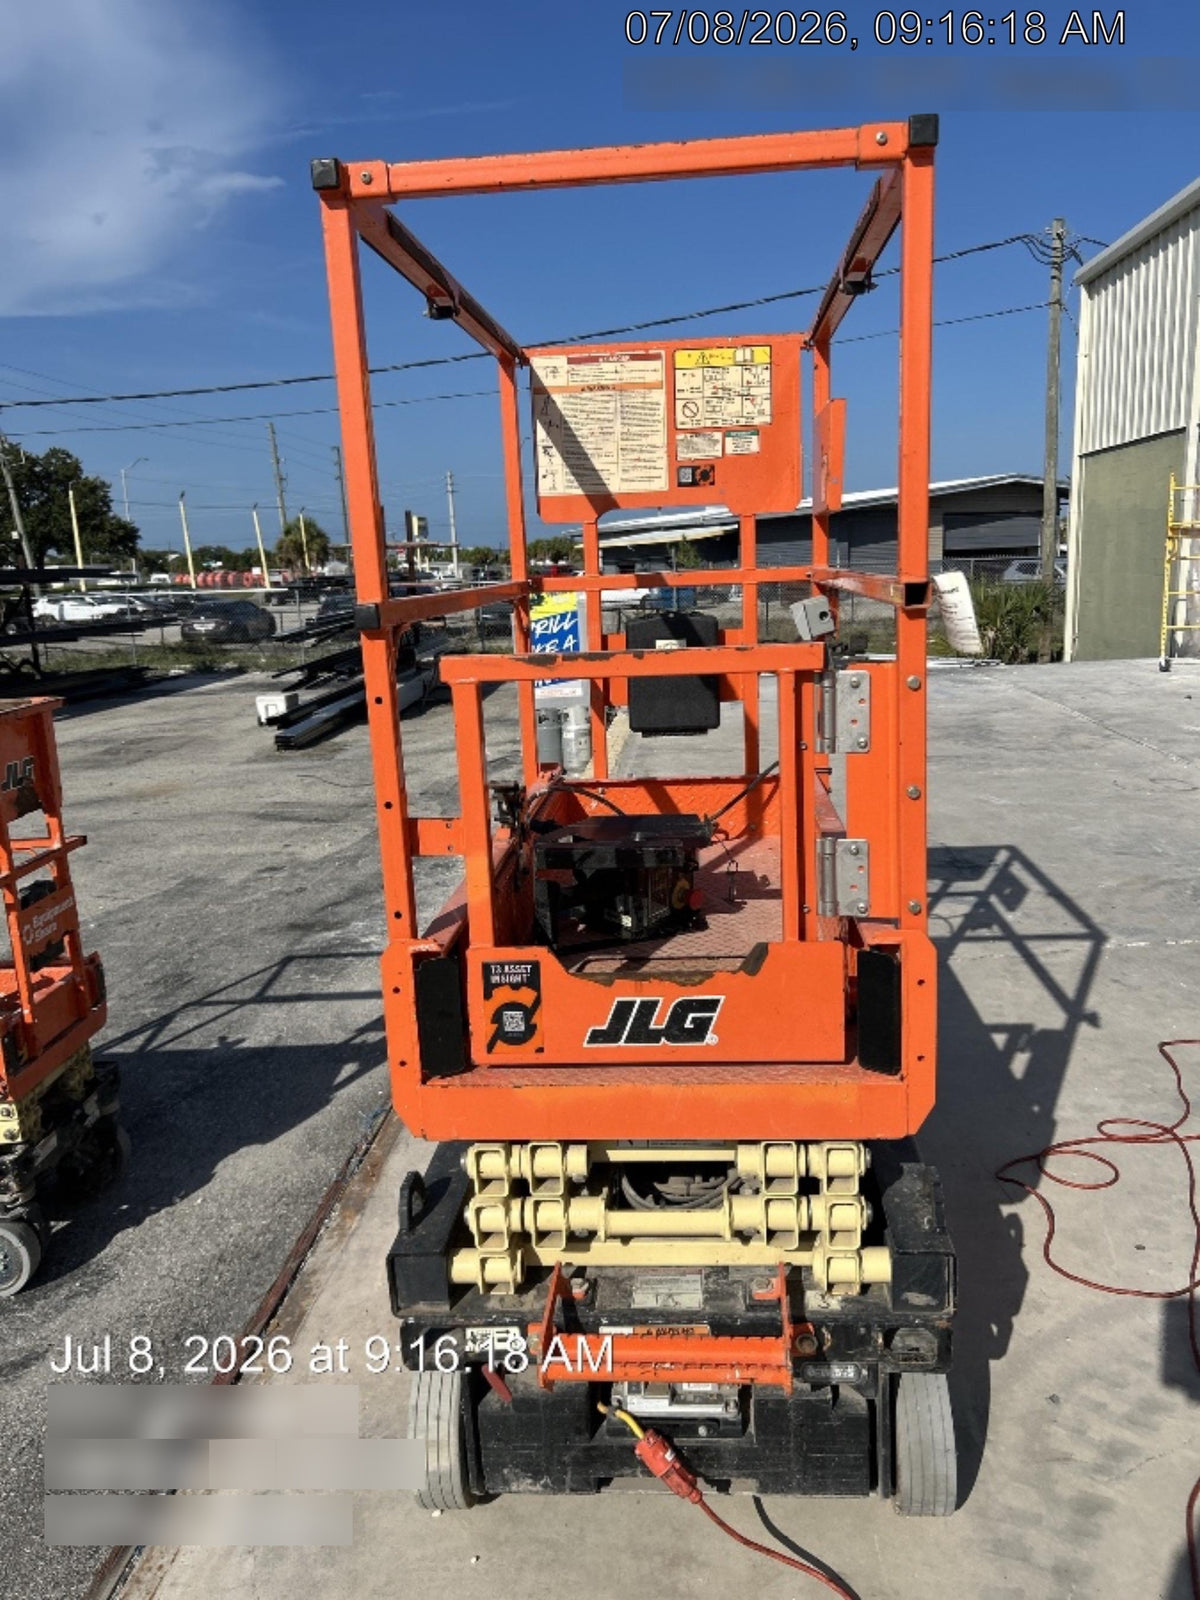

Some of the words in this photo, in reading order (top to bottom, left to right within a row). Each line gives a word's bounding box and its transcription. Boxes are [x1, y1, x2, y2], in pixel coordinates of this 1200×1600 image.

[530, 611, 579, 639] RILL
[562, 633, 577, 653] A
[583, 996, 725, 1047] JLG
